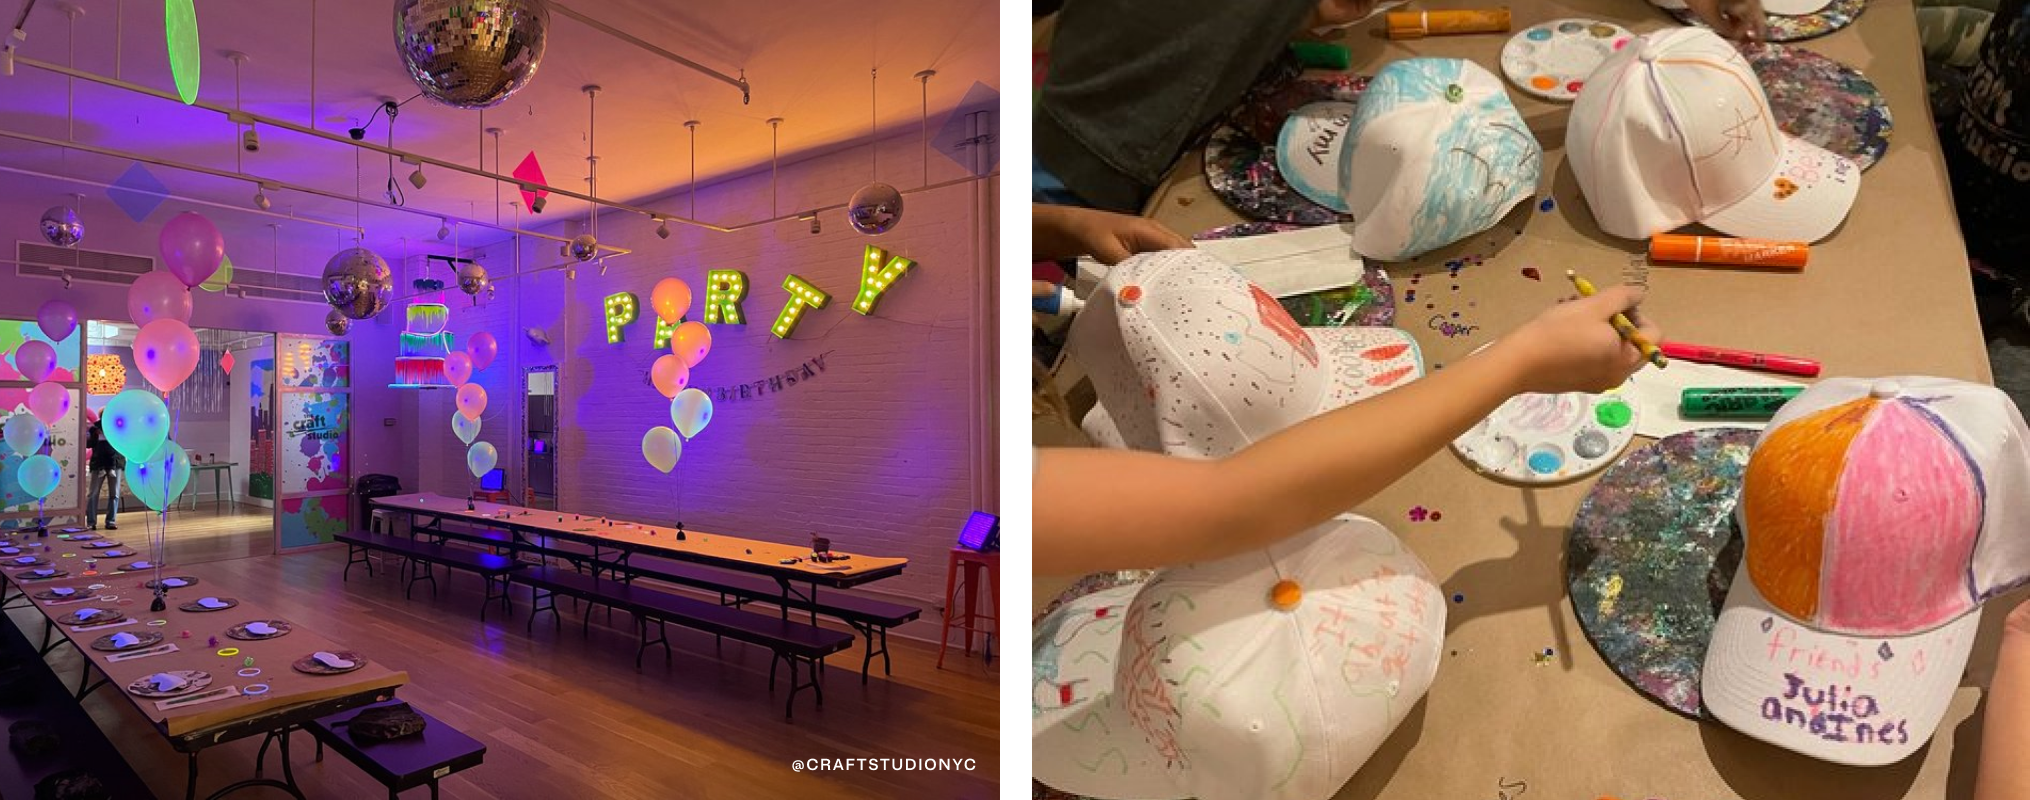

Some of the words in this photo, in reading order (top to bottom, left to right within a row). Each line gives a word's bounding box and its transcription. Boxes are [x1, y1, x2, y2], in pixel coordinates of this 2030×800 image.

[293, 415, 326, 430] craft
[307, 431, 339, 440] studio
[1766, 626, 1882, 680] friends
[1783, 672, 1881, 719] Julia
